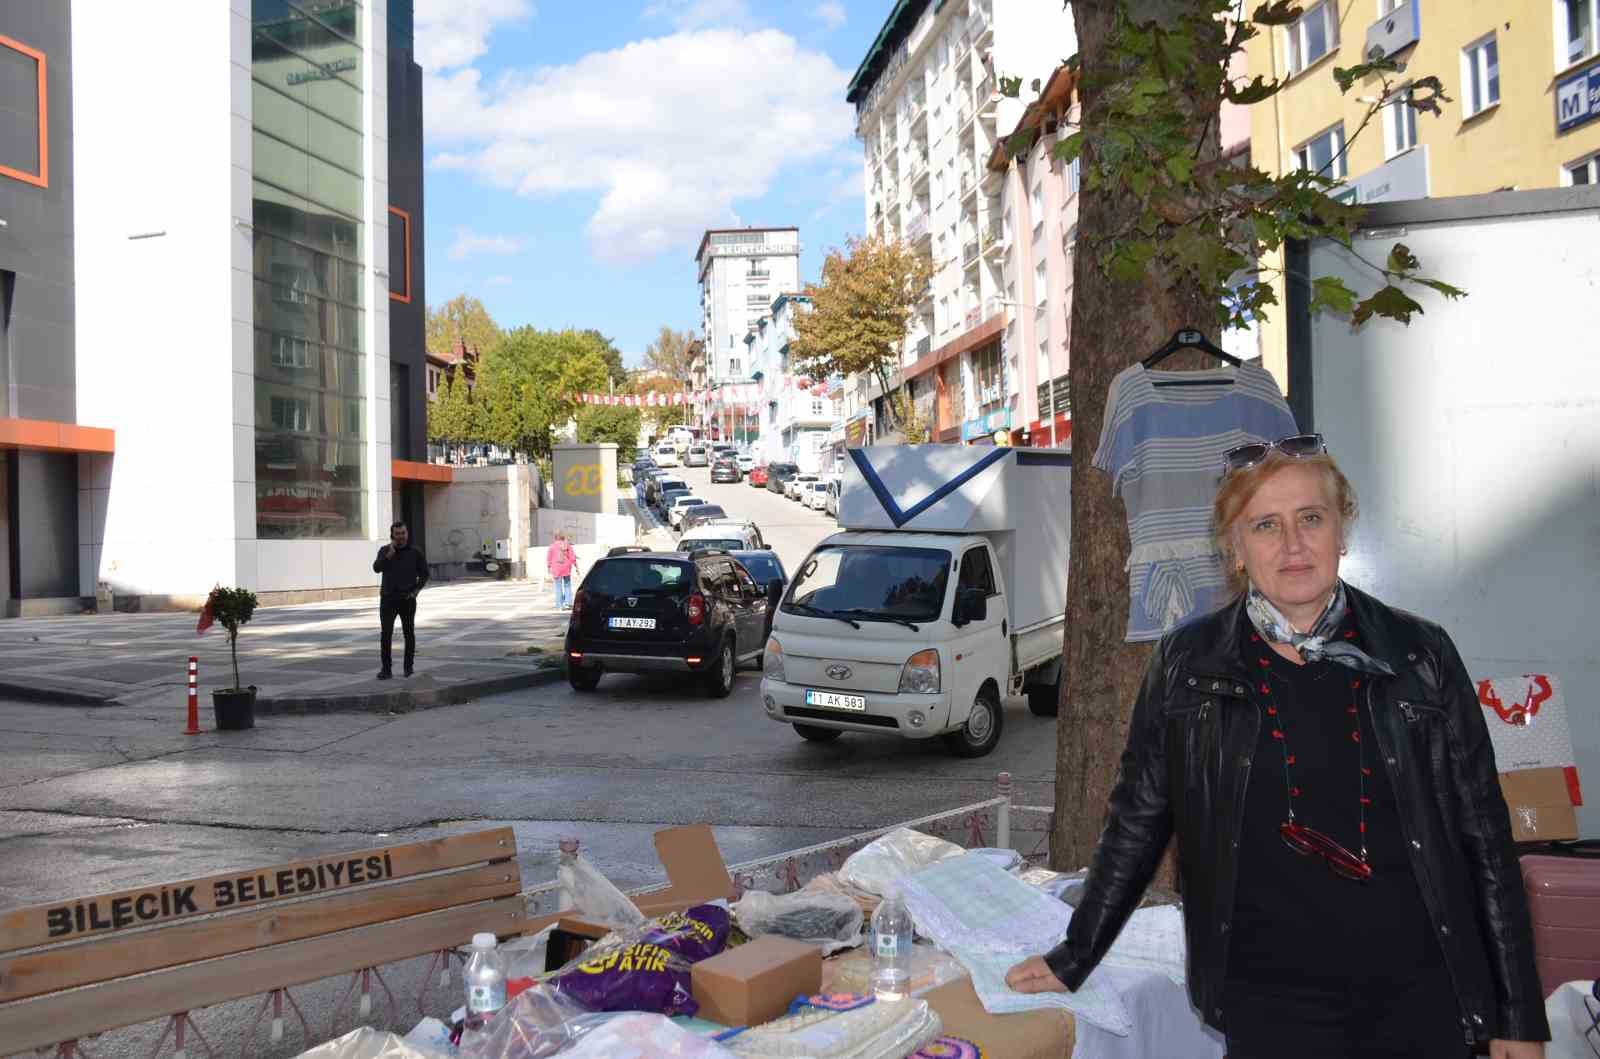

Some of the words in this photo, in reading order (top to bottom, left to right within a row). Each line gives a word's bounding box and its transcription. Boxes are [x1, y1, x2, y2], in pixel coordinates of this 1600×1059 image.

[614, 618, 623, 627] 11
[626, 619, 638, 627] AY
[639, 620, 655, 628] 292
[813, 693, 822, 704] 11
[827, 695, 841, 706] AK
[844, 697, 863, 709] 583
[47, 885, 198, 937] BİLECİK
[213, 850, 392, 907] BELEDİYESİ
[618, 956, 666, 972] ATIK
